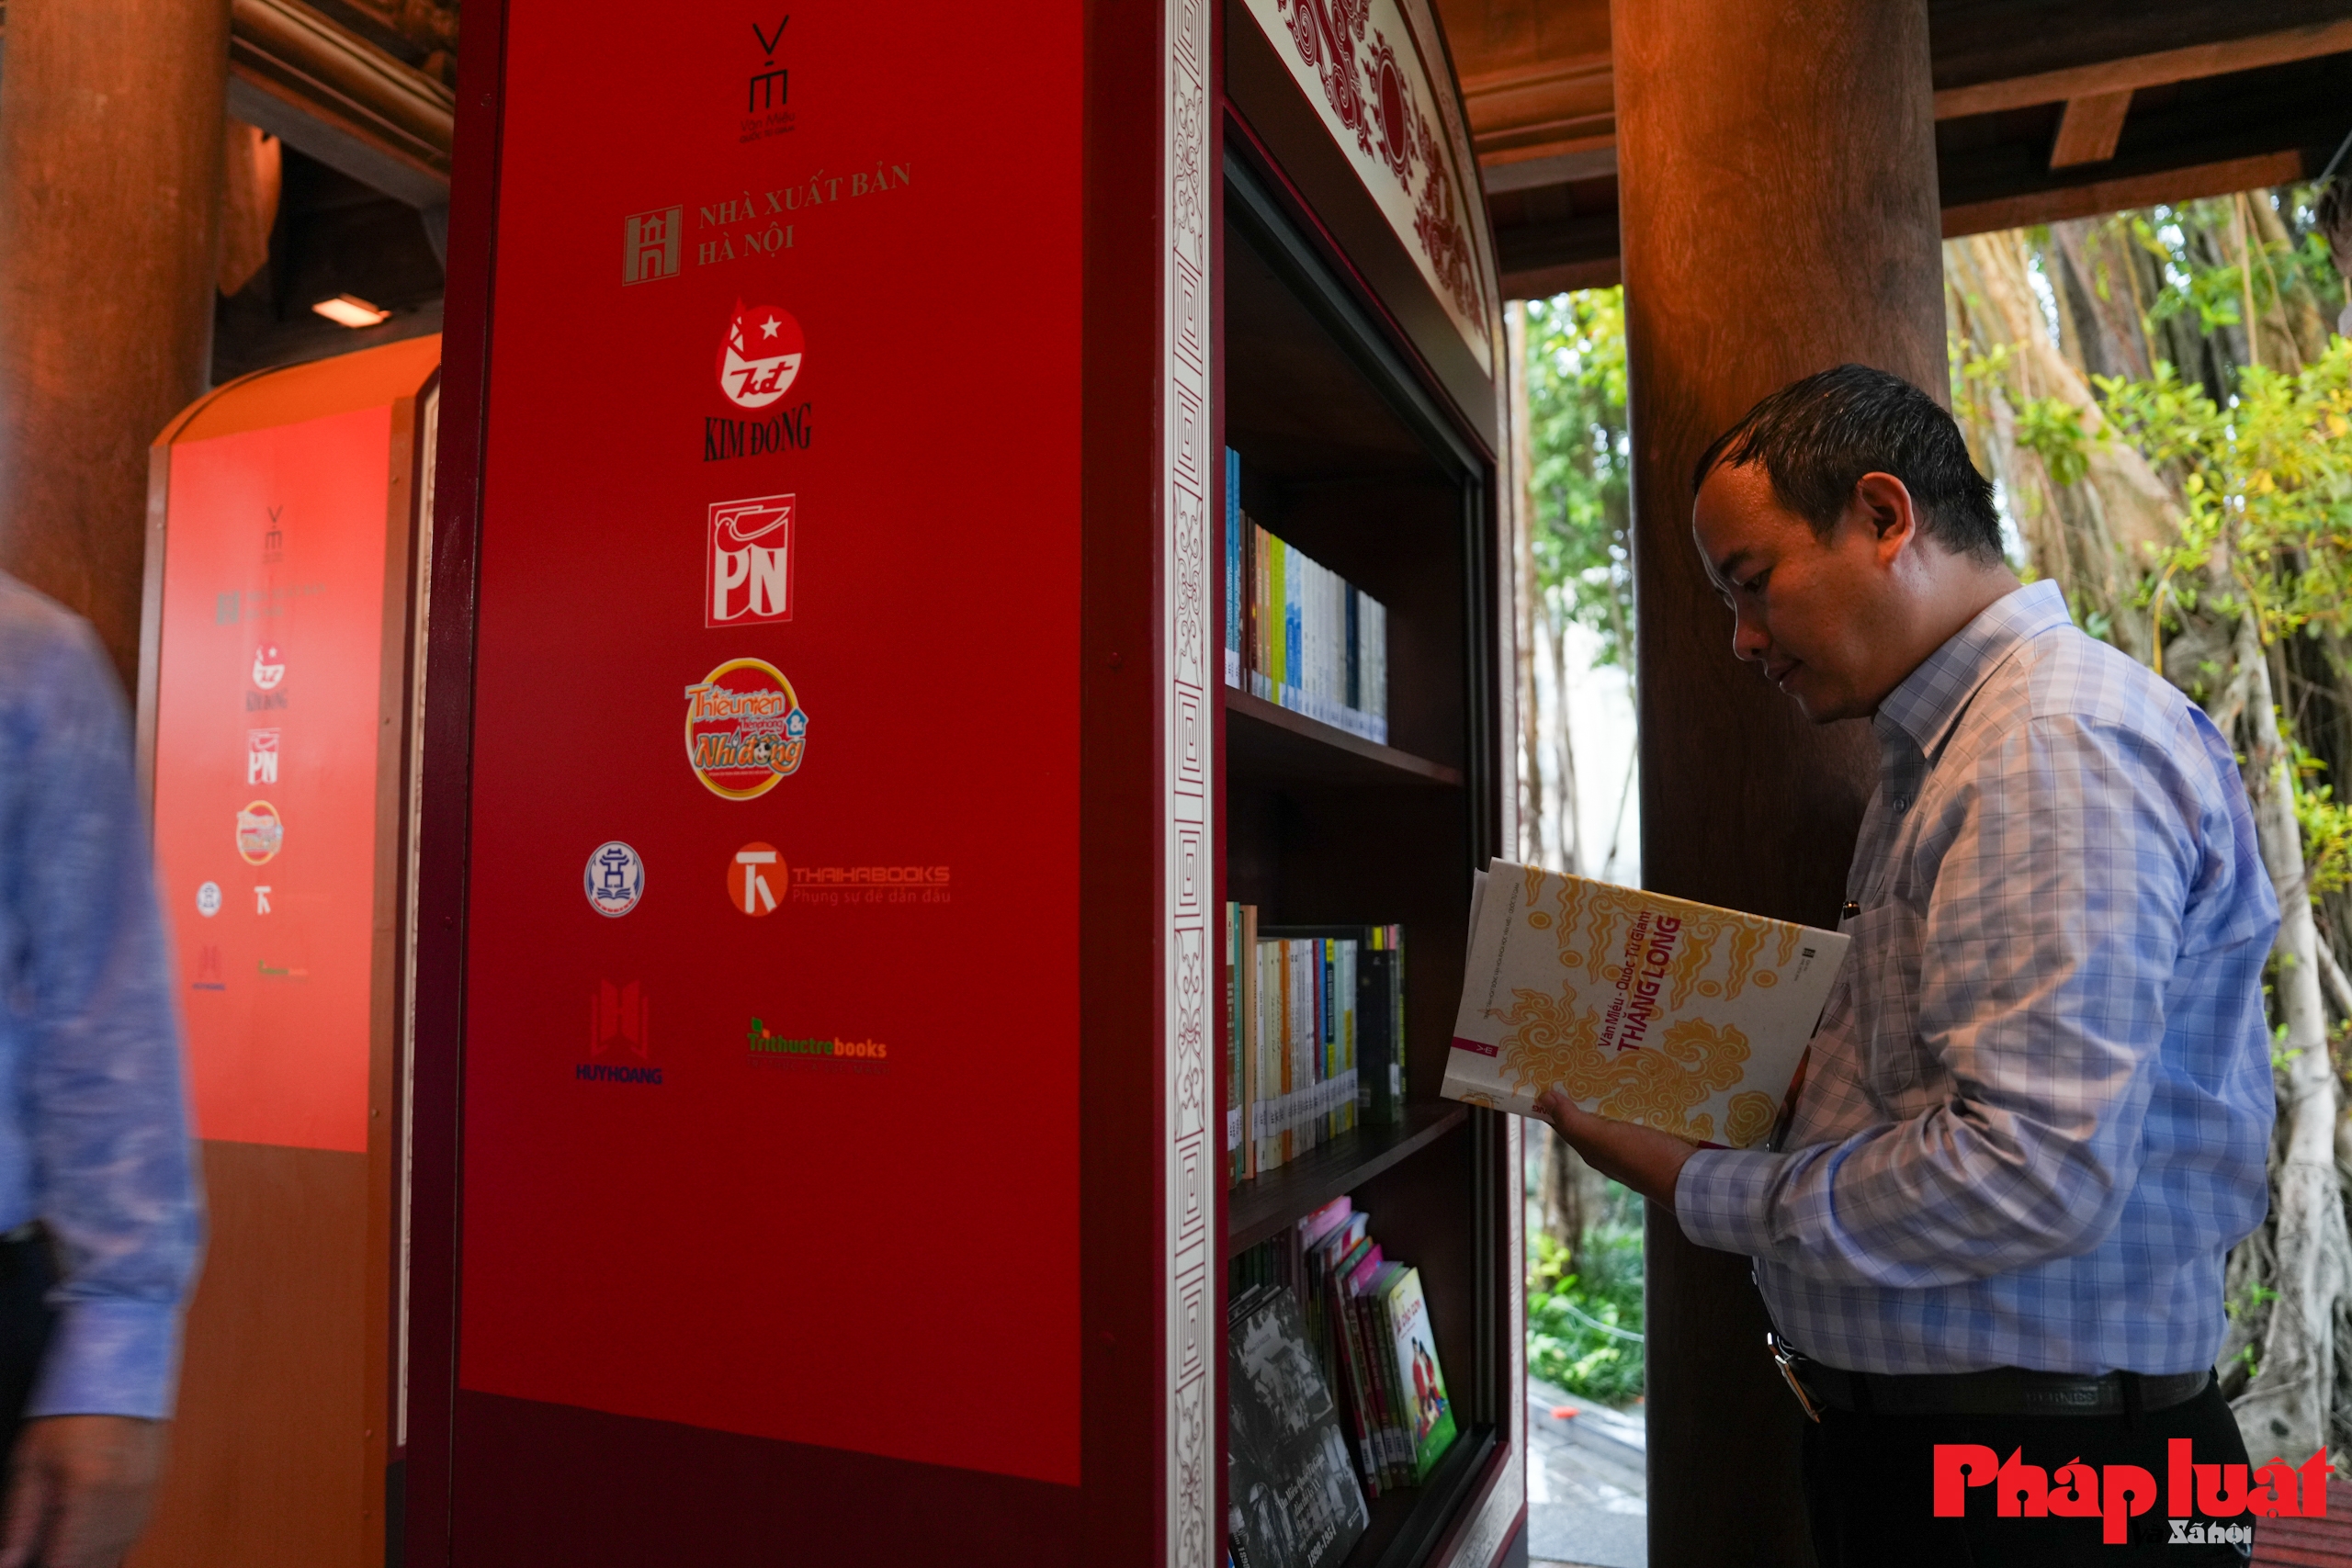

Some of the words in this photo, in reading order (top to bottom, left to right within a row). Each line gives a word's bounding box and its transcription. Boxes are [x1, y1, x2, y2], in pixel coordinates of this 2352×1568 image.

[698, 190, 756, 230] NHÀ
[763, 169, 843, 216] XUẤT
[850, 161, 911, 197] BẢN
[697, 231, 736, 266] HÀ
[742, 221, 796, 258] NỘI
[703, 416, 745, 462] KIM
[751, 401, 812, 457] ĐỒNG
[713, 543, 788, 621] PN
[792, 866, 951, 883] THAIHABOOKS
[793, 889, 838, 906] Phụng
[1631, 911, 1652, 942] Giám
[1624, 942, 1642, 958] Tử
[1615, 961, 1635, 991] Quốc
[1617, 979, 1661, 1052] THĂNG
[1641, 915, 1681, 979] LONG
[1605, 998, 1624, 1025] Miếu
[1598, 1024, 1615, 1047] Văn
[576, 1064, 662, 1085] HUYHOANG
